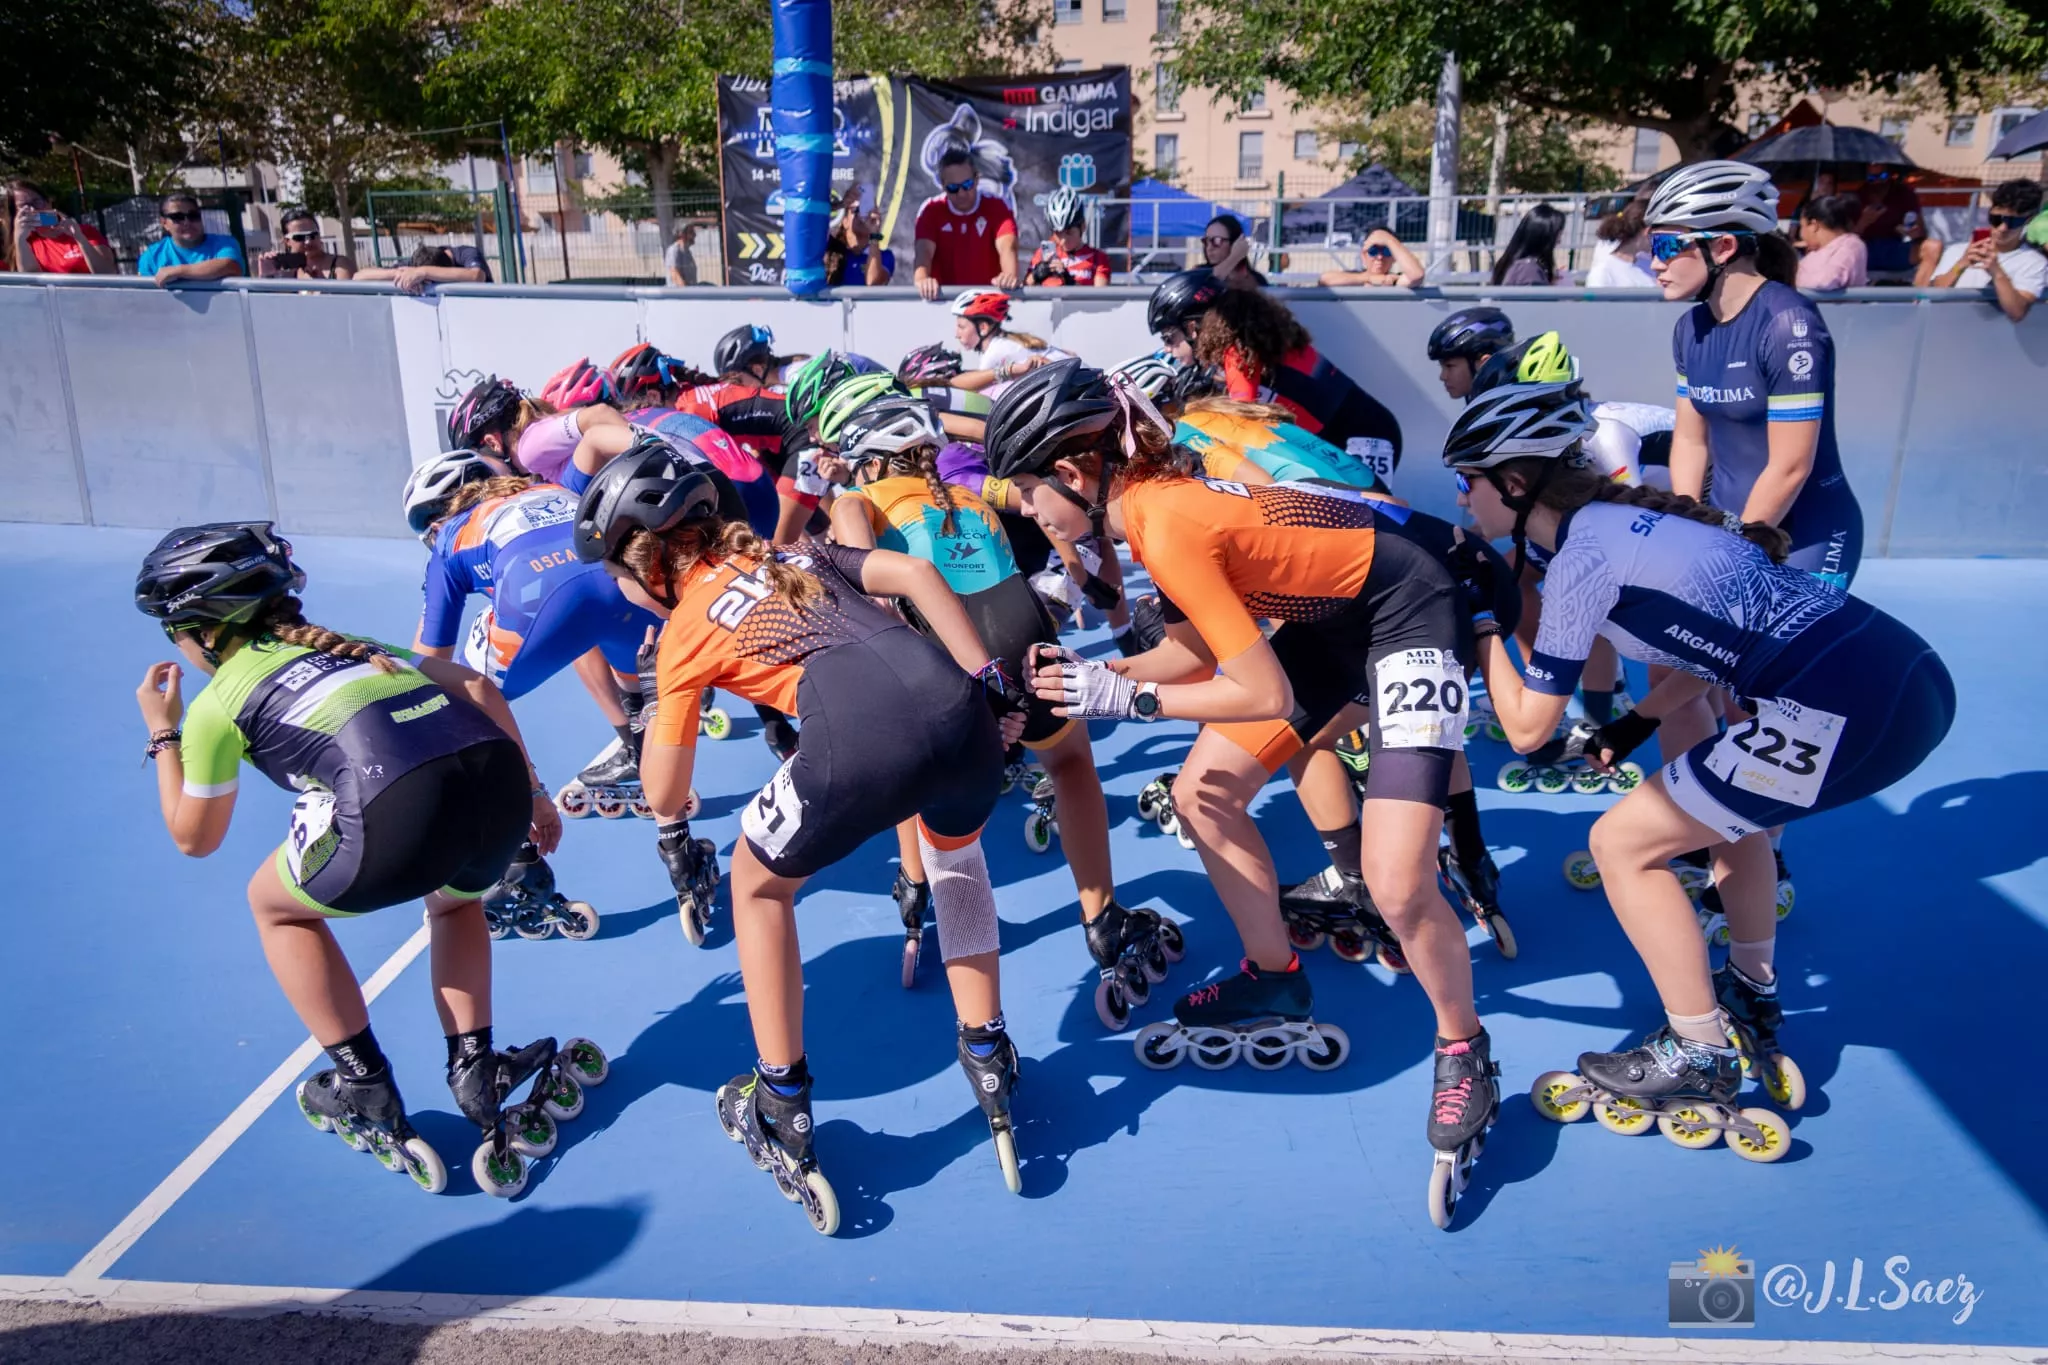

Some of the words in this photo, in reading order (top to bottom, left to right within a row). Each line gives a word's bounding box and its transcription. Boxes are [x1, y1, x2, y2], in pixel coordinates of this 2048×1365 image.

[1040, 82, 1118, 104] GAMMA
[1025, 104, 1120, 138] Indigar
[1383, 677, 1464, 717] 220
[1732, 717, 1822, 775] 223
